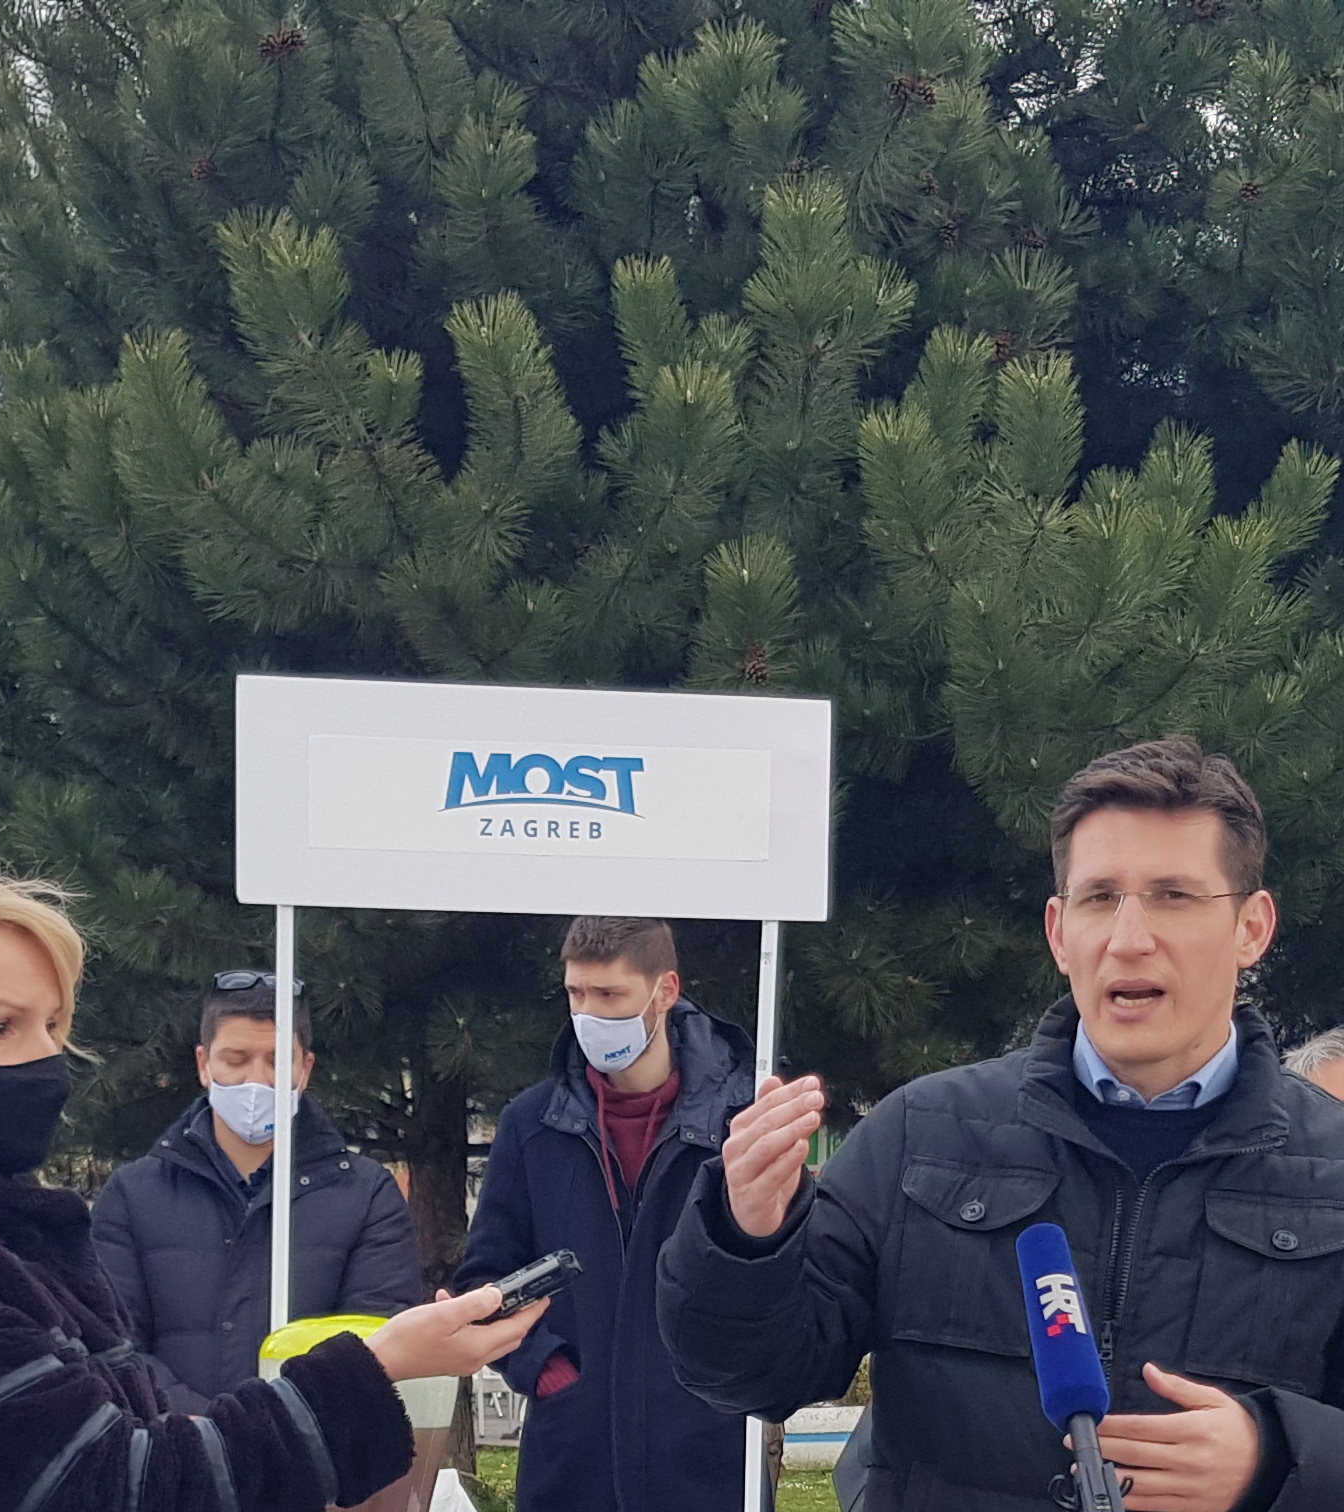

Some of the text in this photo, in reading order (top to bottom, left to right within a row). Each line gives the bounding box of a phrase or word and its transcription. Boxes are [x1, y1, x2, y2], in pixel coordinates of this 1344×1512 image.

[444, 751, 644, 815] MOST
[479, 818, 603, 839] ZAGREB
[1035, 1273, 1087, 1335] HRT
